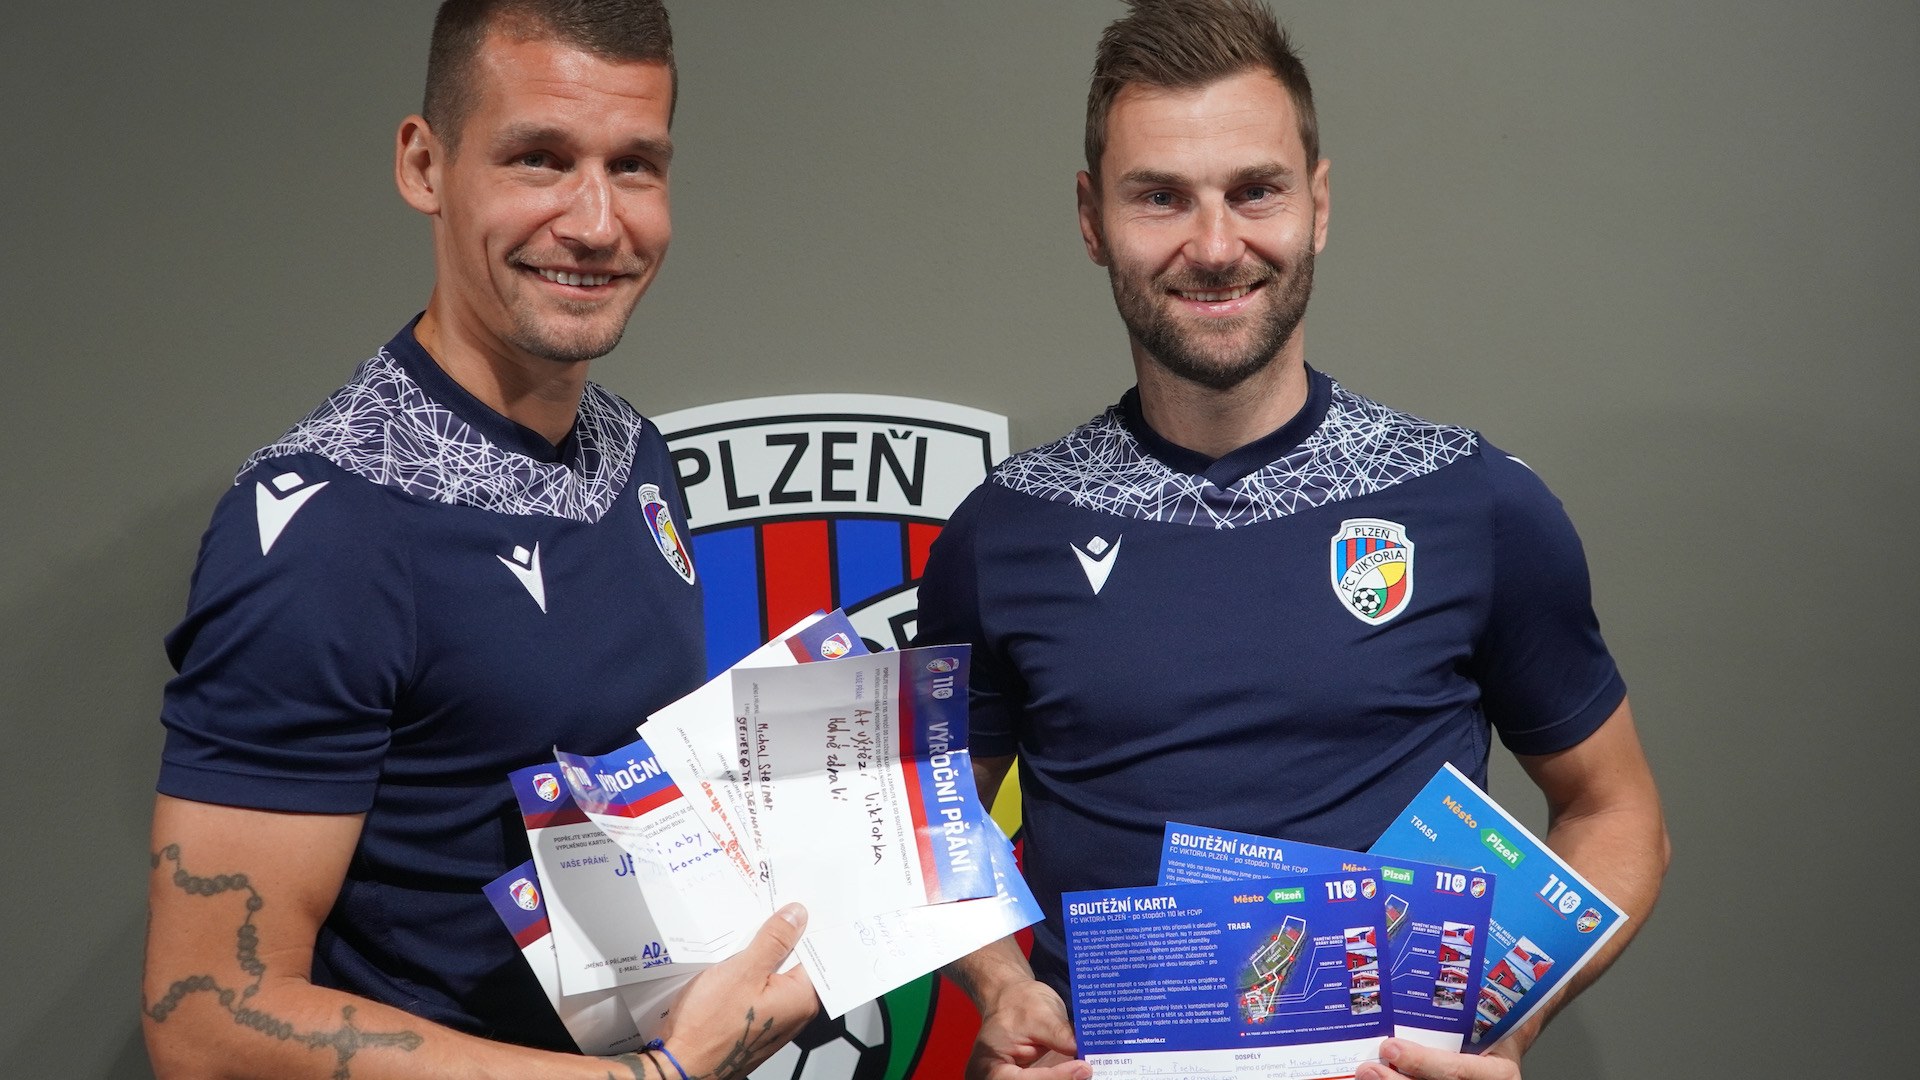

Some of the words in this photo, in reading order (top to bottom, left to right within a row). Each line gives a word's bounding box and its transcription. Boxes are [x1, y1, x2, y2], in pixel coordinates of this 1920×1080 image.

[671, 428, 928, 520] PLZEŇ
[1355, 527, 1390, 539] PLZEŇ
[1342, 576, 1355, 592] FC
[1352, 550, 1404, 576] VIKTORIA
[928, 722, 965, 803] VÝROČNÍ
[595, 757, 667, 793] VÝROČN
[582, 830, 607, 841] VIKTORC
[1410, 815, 1438, 843] TRASA
[1442, 795, 1477, 829] Město
[1486, 832, 1520, 864] Plzeň
[555, 839, 587, 851] VYPLNĚNOU
[588, 839, 606, 848] KARTU
[940, 805, 973, 873] PŘÁNÍ
[1171, 832, 1237, 854] SOUTĚŽNÍ
[1239, 843, 1284, 862] KARTA
[560, 859, 581, 869] VAŠE
[582, 856, 610, 868] PŘÁNÍ:
[1179, 848, 1207, 858] VIKTORIA
[1208, 851, 1229, 862] PLZEŇ
[1244, 858, 1269, 868] stopách
[1271, 862, 1280, 870] 110
[1281, 863, 1291, 872] let
[1291, 865, 1309, 874] FCVP
[1383, 869, 1411, 882] Plzeň
[1233, 894, 1264, 904] Město
[1274, 890, 1302, 901] Plzeň
[1539, 873, 1582, 915] 110
[1069, 897, 1131, 916] SOUTĚŽNÍ
[1135, 896, 1177, 911] KARTA
[1080, 915, 1106, 923] VIKTORIA
[1107, 914, 1126, 922] PLZEŇ
[1142, 911, 1166, 920] stopách
[1227, 922, 1251, 930] TRASA
[583, 960, 604, 970] JMÉNO
[618, 965, 640, 974] E-MAIL:
[1234, 1053, 1261, 1061] DOSPĚLÝ
